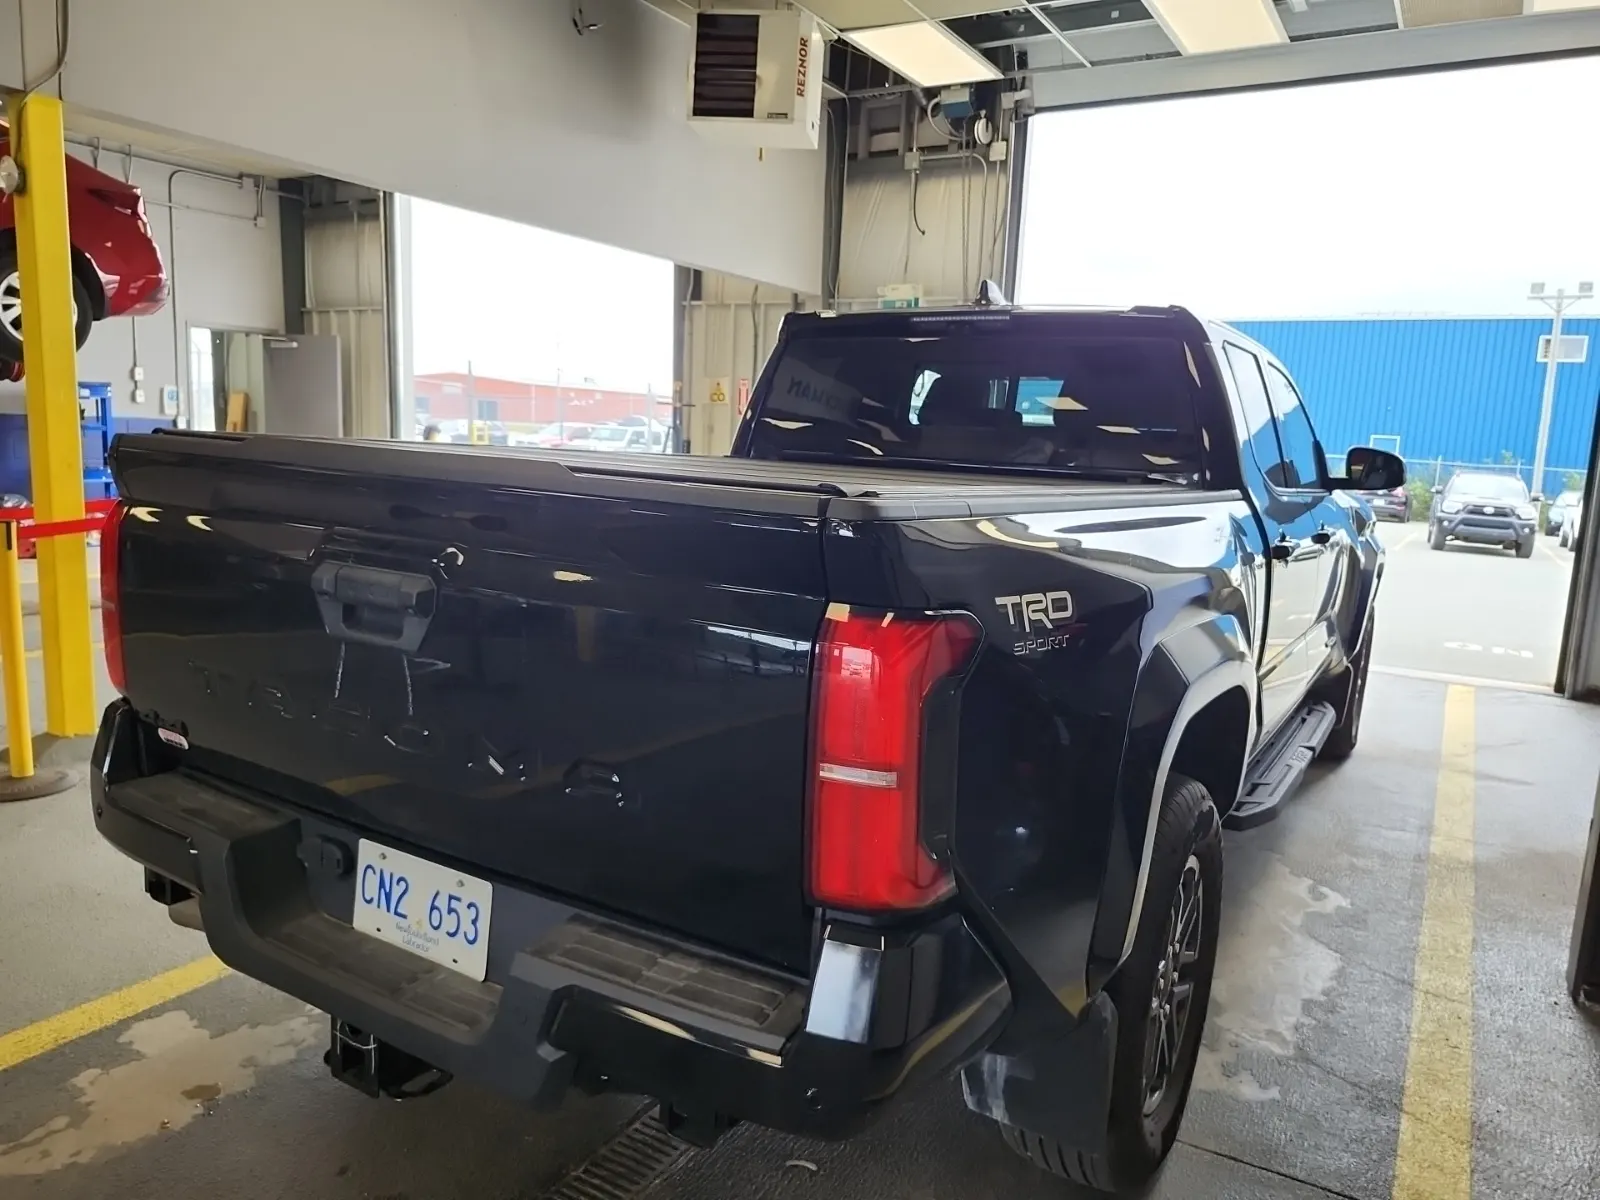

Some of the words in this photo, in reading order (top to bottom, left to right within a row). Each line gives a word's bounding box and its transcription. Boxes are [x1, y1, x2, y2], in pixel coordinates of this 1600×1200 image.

[796, 37, 809, 97] REZNOR
[995, 591, 1073, 632] TRD
[1013, 634, 1070, 656] SPORT
[362, 864, 410, 920] CN2
[429, 889, 480, 945] 653
